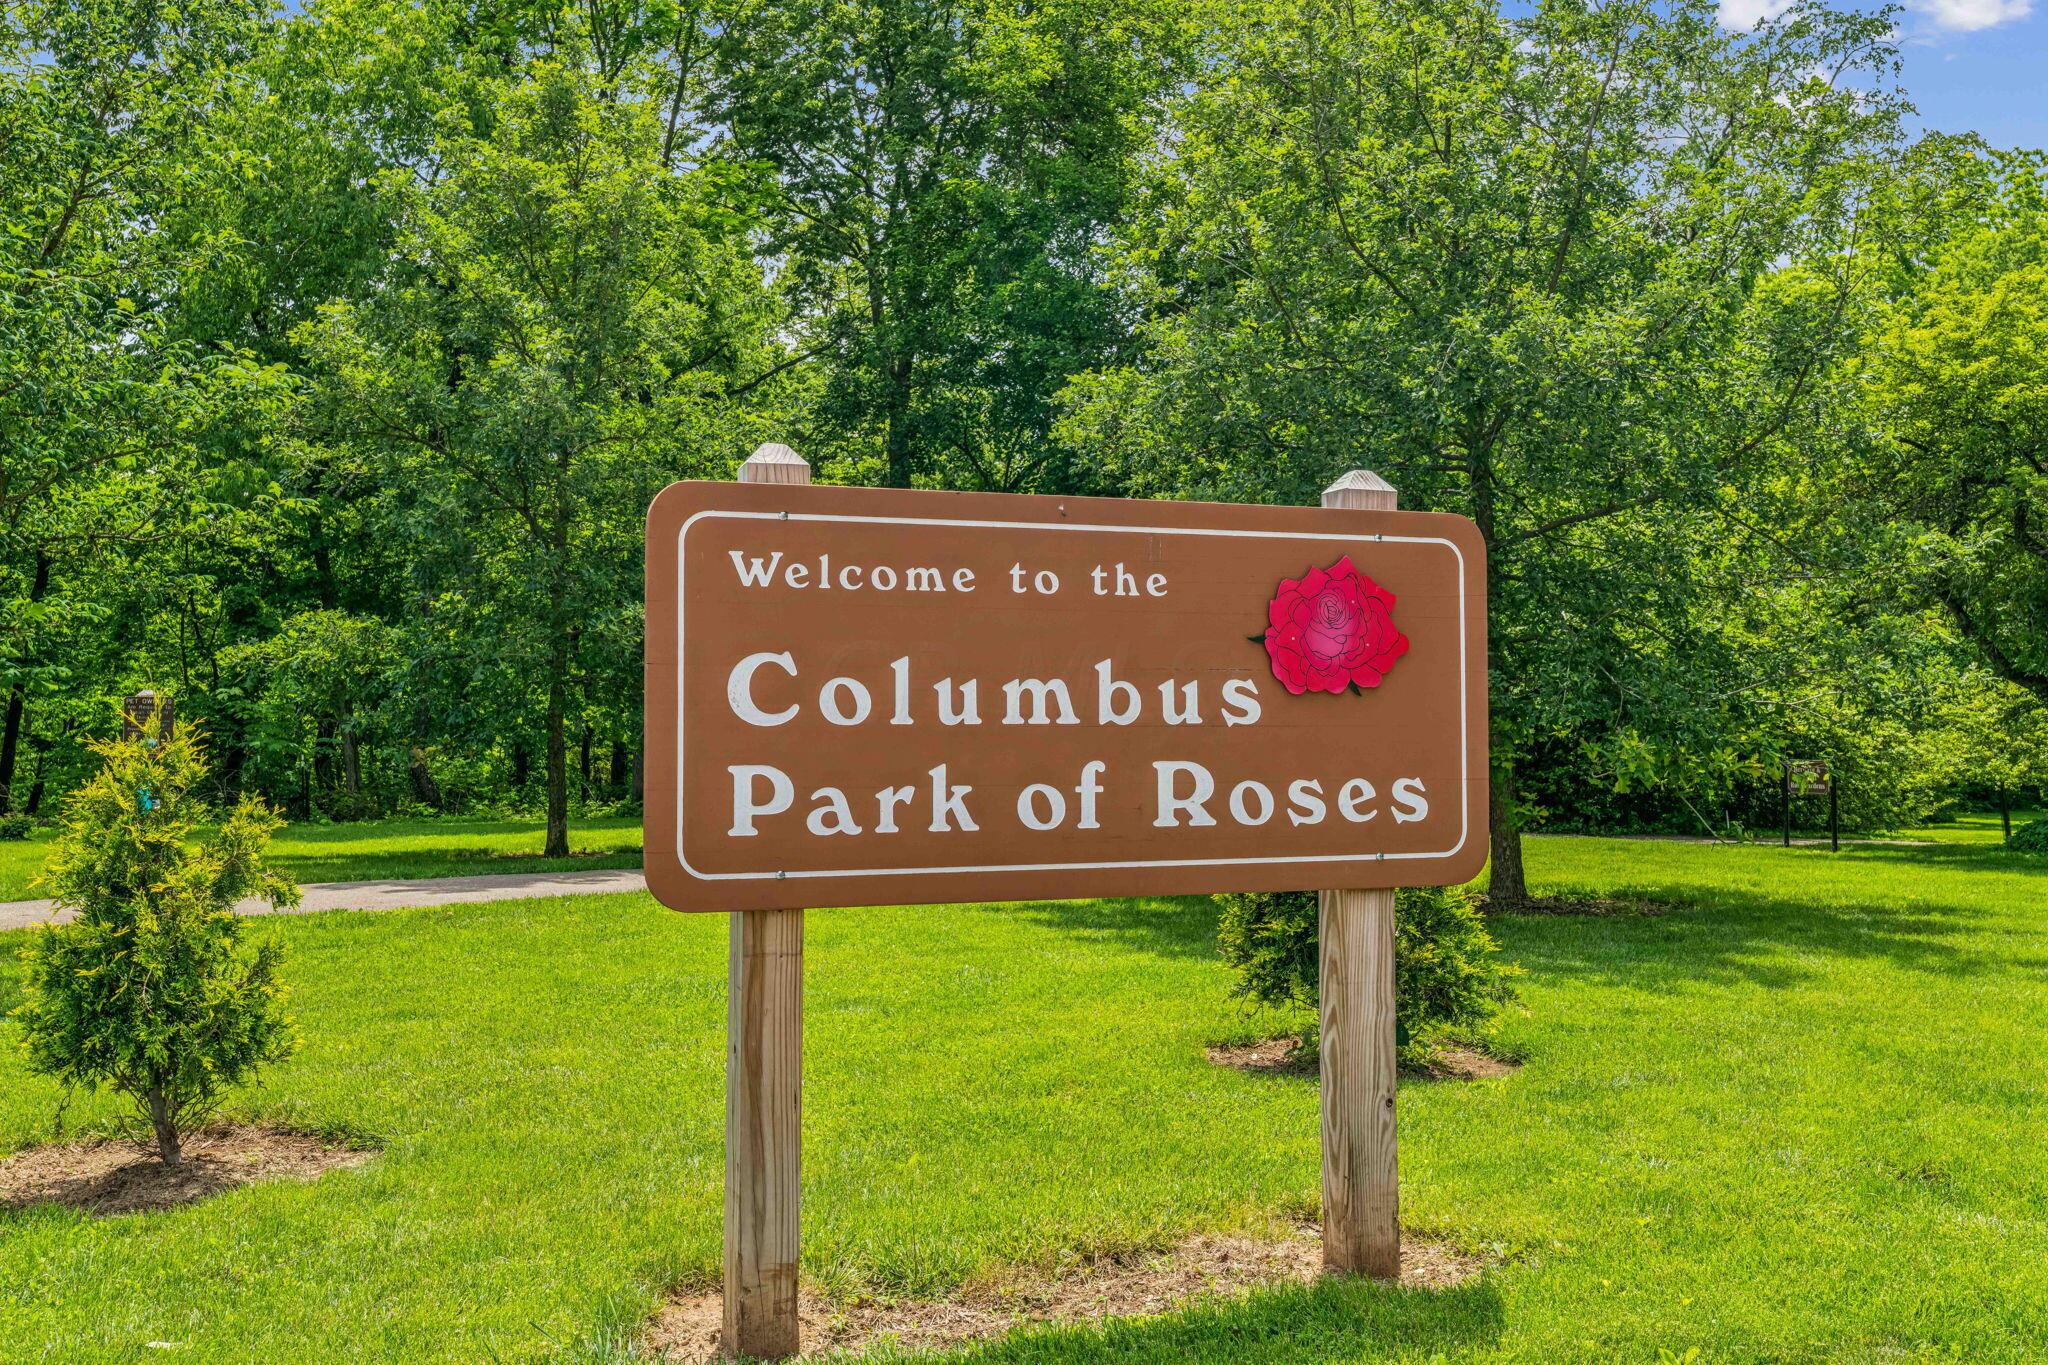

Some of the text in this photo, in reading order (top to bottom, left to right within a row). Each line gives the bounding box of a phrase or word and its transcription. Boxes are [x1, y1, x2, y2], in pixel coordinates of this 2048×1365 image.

[728, 550, 1169, 599] Welcome to the
[726, 651, 1263, 728] Columbus
[727, 760, 1430, 837] Park of Roses
